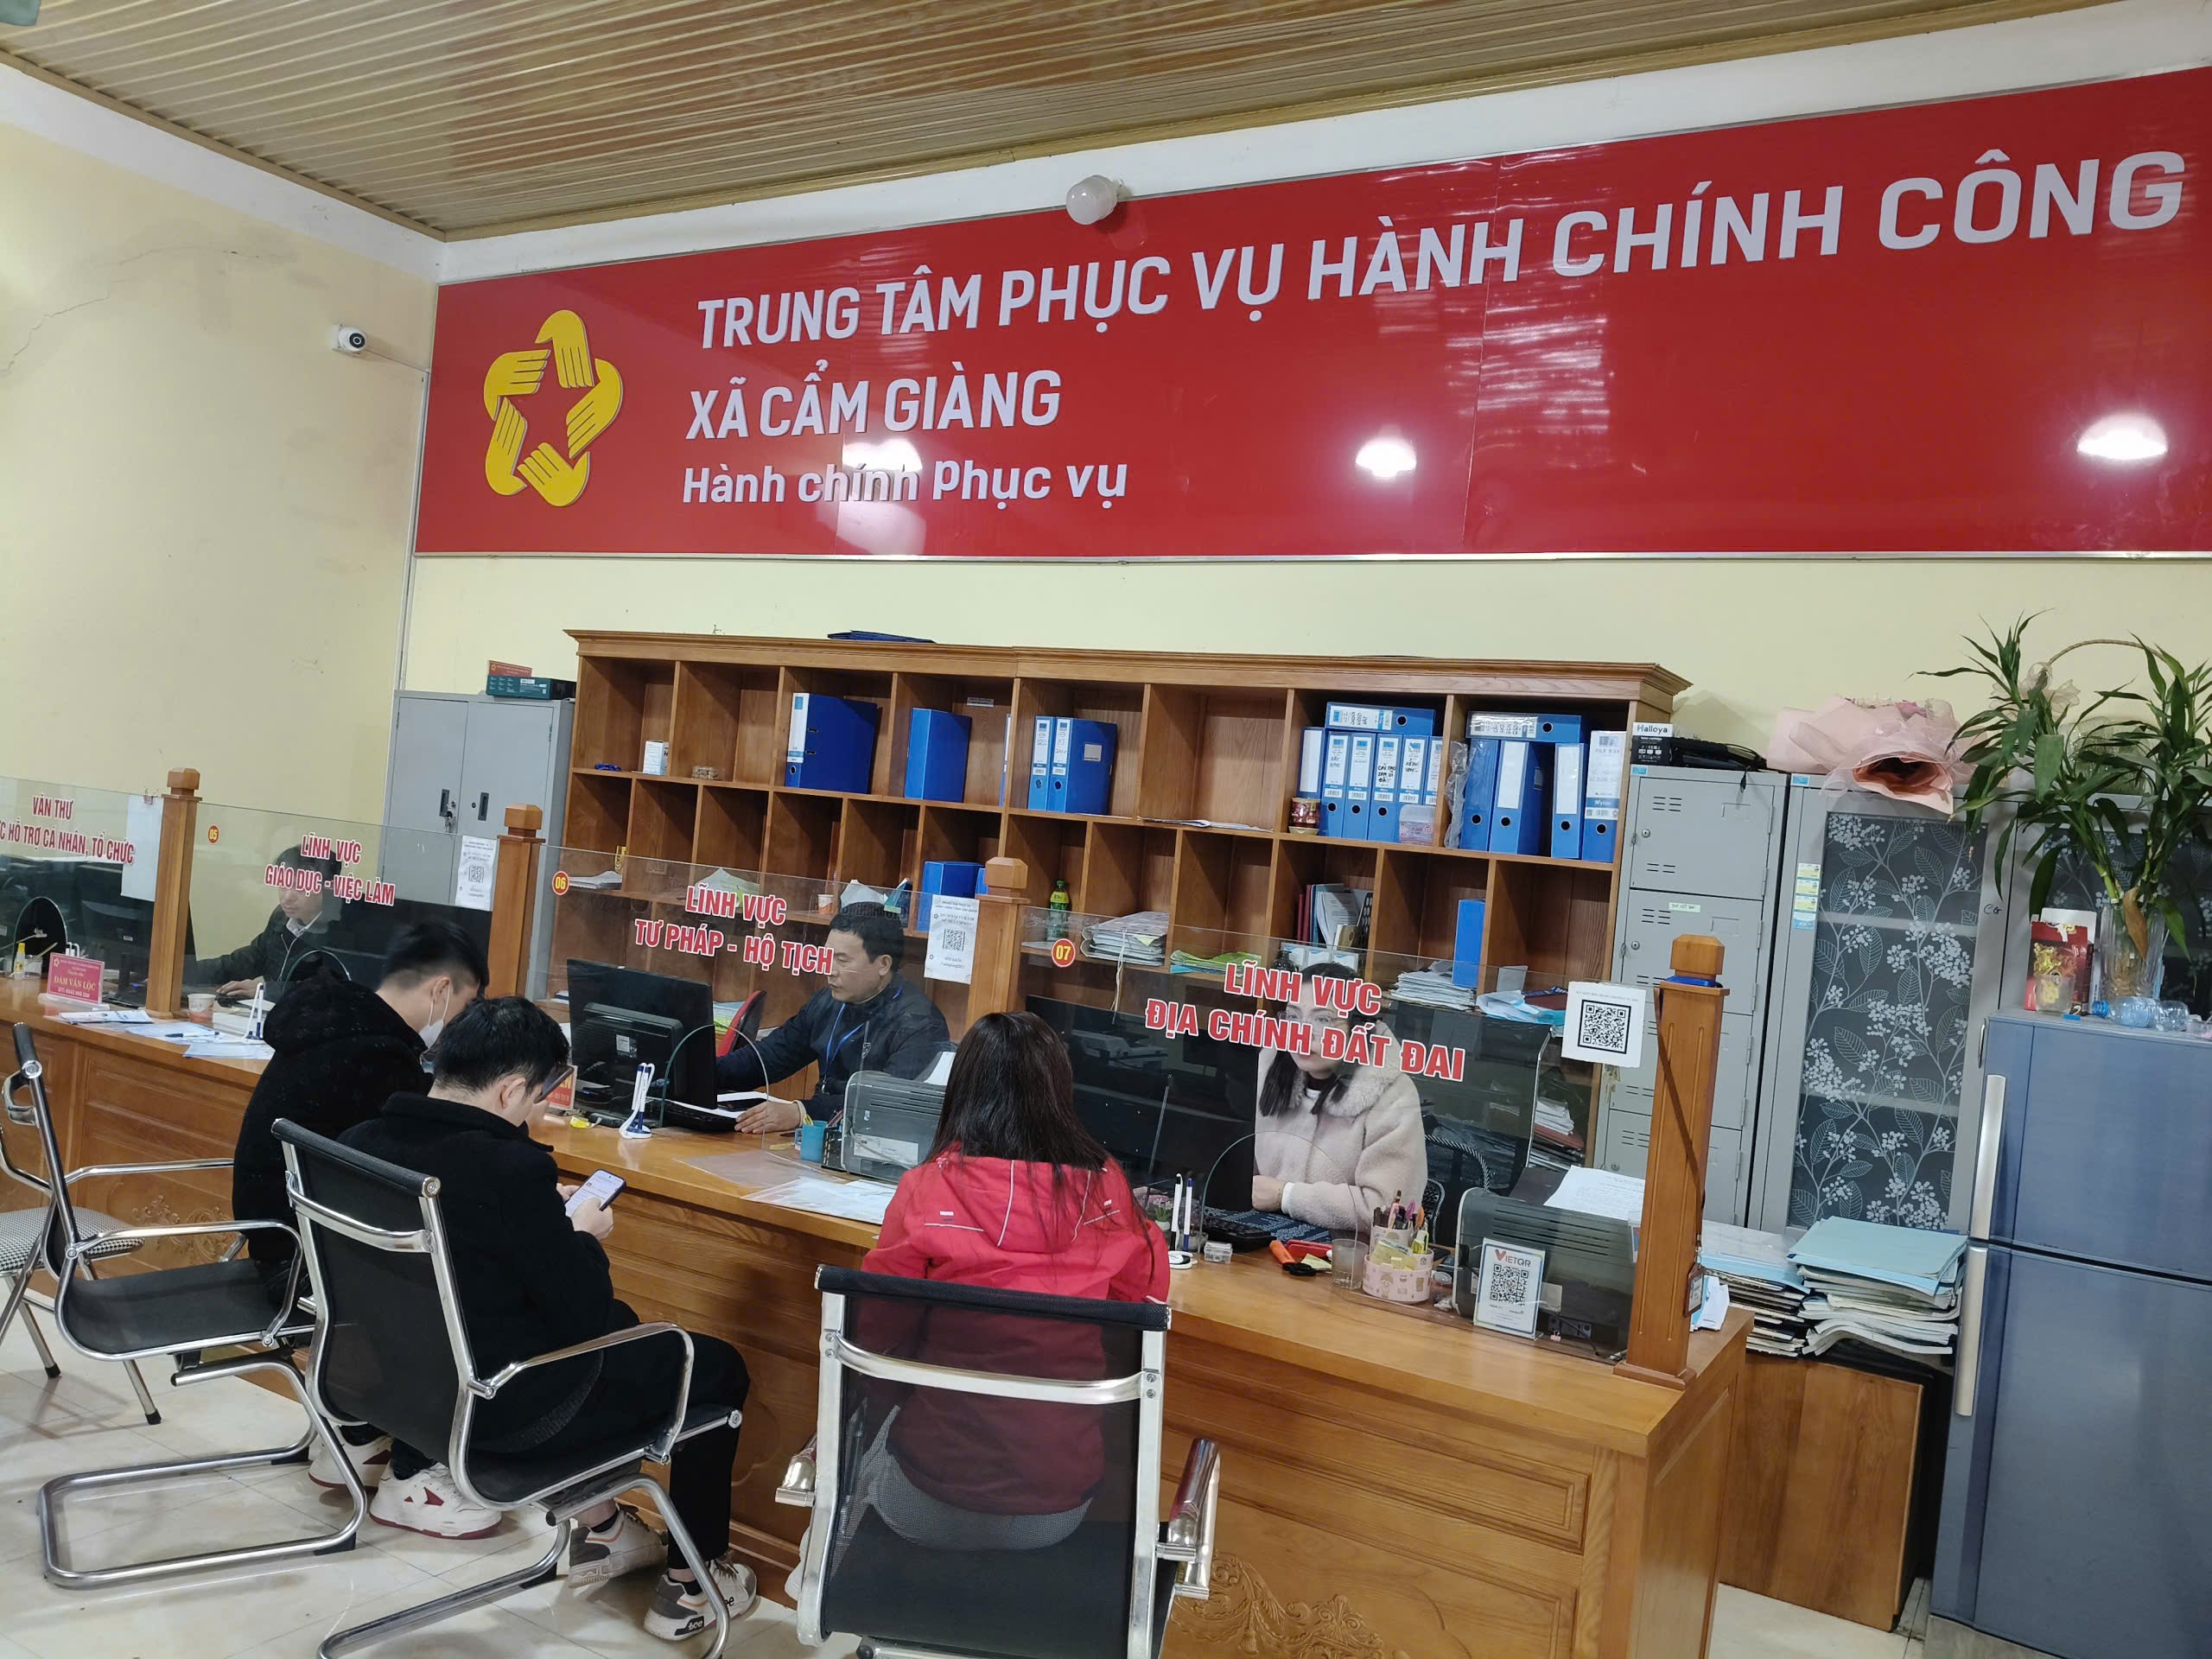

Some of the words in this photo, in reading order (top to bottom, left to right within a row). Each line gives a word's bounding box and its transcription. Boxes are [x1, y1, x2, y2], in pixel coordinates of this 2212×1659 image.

[697, 286, 861, 349] TRUNG
[875, 264, 982, 335] TÂM
[998, 256, 1171, 333] PHỤC
[1192, 243, 1285, 322] VỤ
[1307, 216, 1523, 301] HÀNH
[1552, 180, 1843, 277] CHÍNH
[1878, 149, 2185, 250] CÔNG
[685, 376, 749, 439] XÃ
[760, 359, 868, 436] CẨM
[884, 361, 1061, 432] GIÀNG
[683, 463, 785, 503] Hành
[798, 463, 918, 502] chính
[933, 460, 1051, 510] Phục
[1066, 463, 1127, 509] vụ
[1637, 725, 1668, 734] Halloya
[33, 794, 52, 817] VĂN
[55, 798, 74, 820] THƯ
[24, 825, 41, 850] TRỢ
[43, 825, 56, 849] CÁ
[92, 830, 105, 858] TỔ
[107, 838, 135, 863] CHỨC
[209, 828, 218, 840] 05
[301, 832, 331, 860] LĨNH
[336, 838, 362, 867] VỰC
[265, 862, 294, 889] GIÁO
[296, 868, 322, 897] DỤC
[334, 873, 363, 904] VIỆC
[365, 878, 396, 906] LÀM
[555, 876, 567, 890] 06
[685, 883, 735, 918] LĨNH
[742, 893, 787, 928] VỰC
[635, 918, 663, 947] TƯ
[664, 924, 723, 957] PHÁP
[744, 933, 776, 971] HỘ
[781, 941, 834, 976] TỊCH
[1056, 944, 1071, 961] 07
[1224, 959, 1302, 1004] LĨNH
[1312, 975, 1382, 1020] VỰC
[1145, 998, 1199, 1039] ĐỊA
[1207, 1008, 1313, 1055] CHÍNH
[1320, 1021, 1391, 1068] ĐẤT
[1400, 1039, 1466, 1082] ĐAI
[1495, 1249, 1531, 1268] VIETQR
